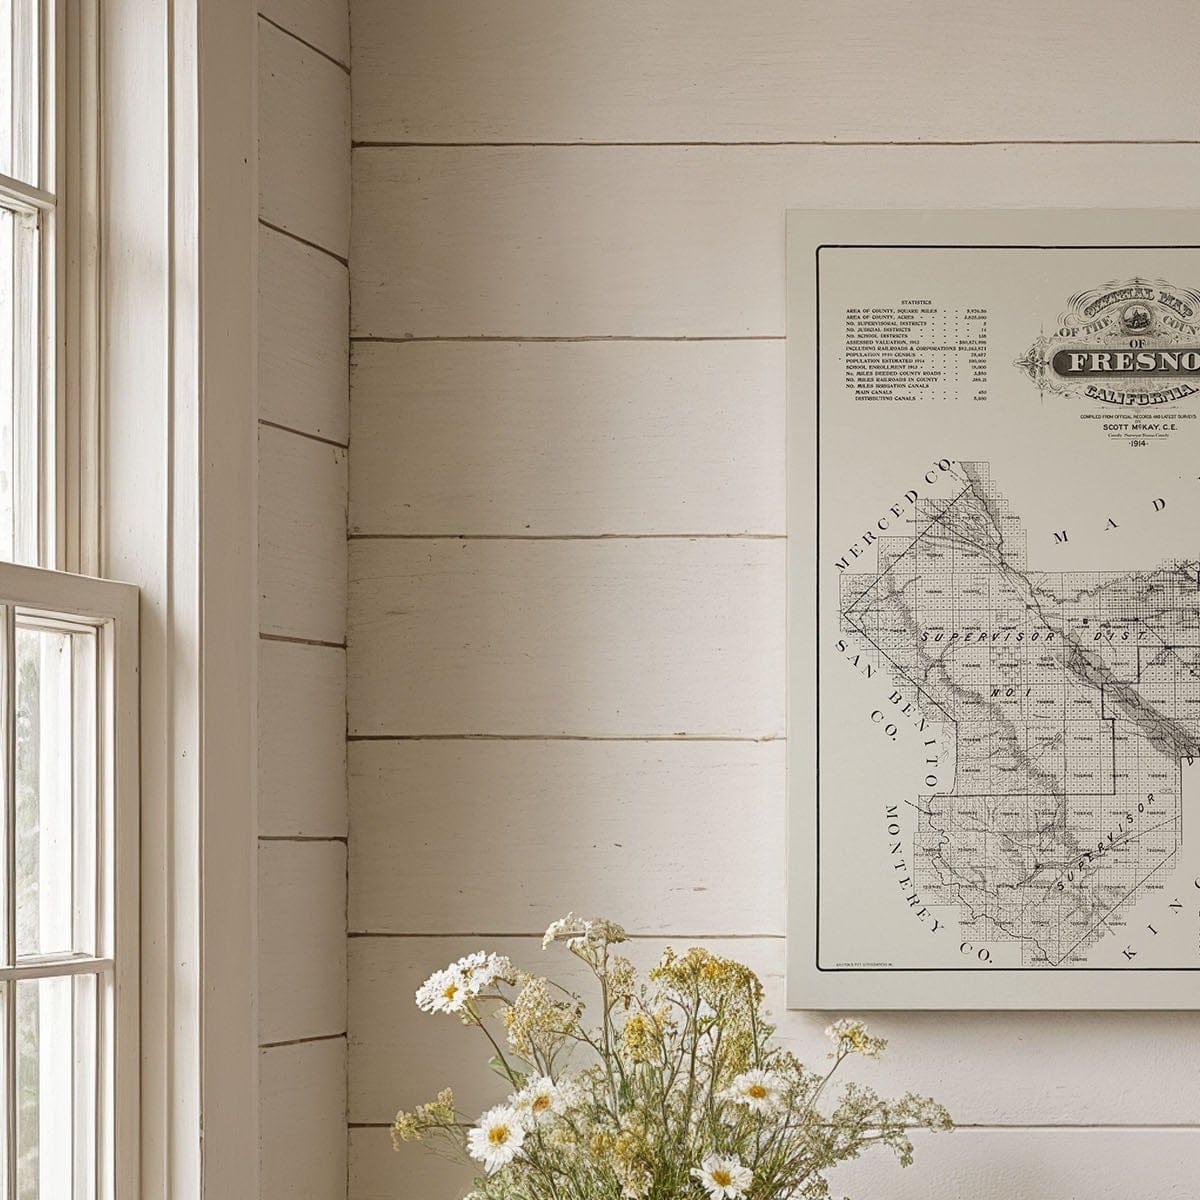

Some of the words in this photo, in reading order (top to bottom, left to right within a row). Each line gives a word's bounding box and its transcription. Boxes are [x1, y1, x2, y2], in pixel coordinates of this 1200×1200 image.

[1159, 290, 1194, 318] MAP
[1058, 326, 1080, 338] OF
[1082, 315, 1114, 335] THE
[1129, 339, 1146, 349] OF
[1084, 384, 1200, 406] CALIFORNIA.
[834, 489, 919, 574] MERCED
[924, 458, 956, 486] CO.
[921, 631, 1055, 643] SUPERVISOR
[835, 639, 878, 679] SAN
[870, 710, 898, 742] CO.
[888, 690, 938, 788] BENITO
[885, 804, 945, 935] MONTEREY
[958, 941, 994, 966] CO.
